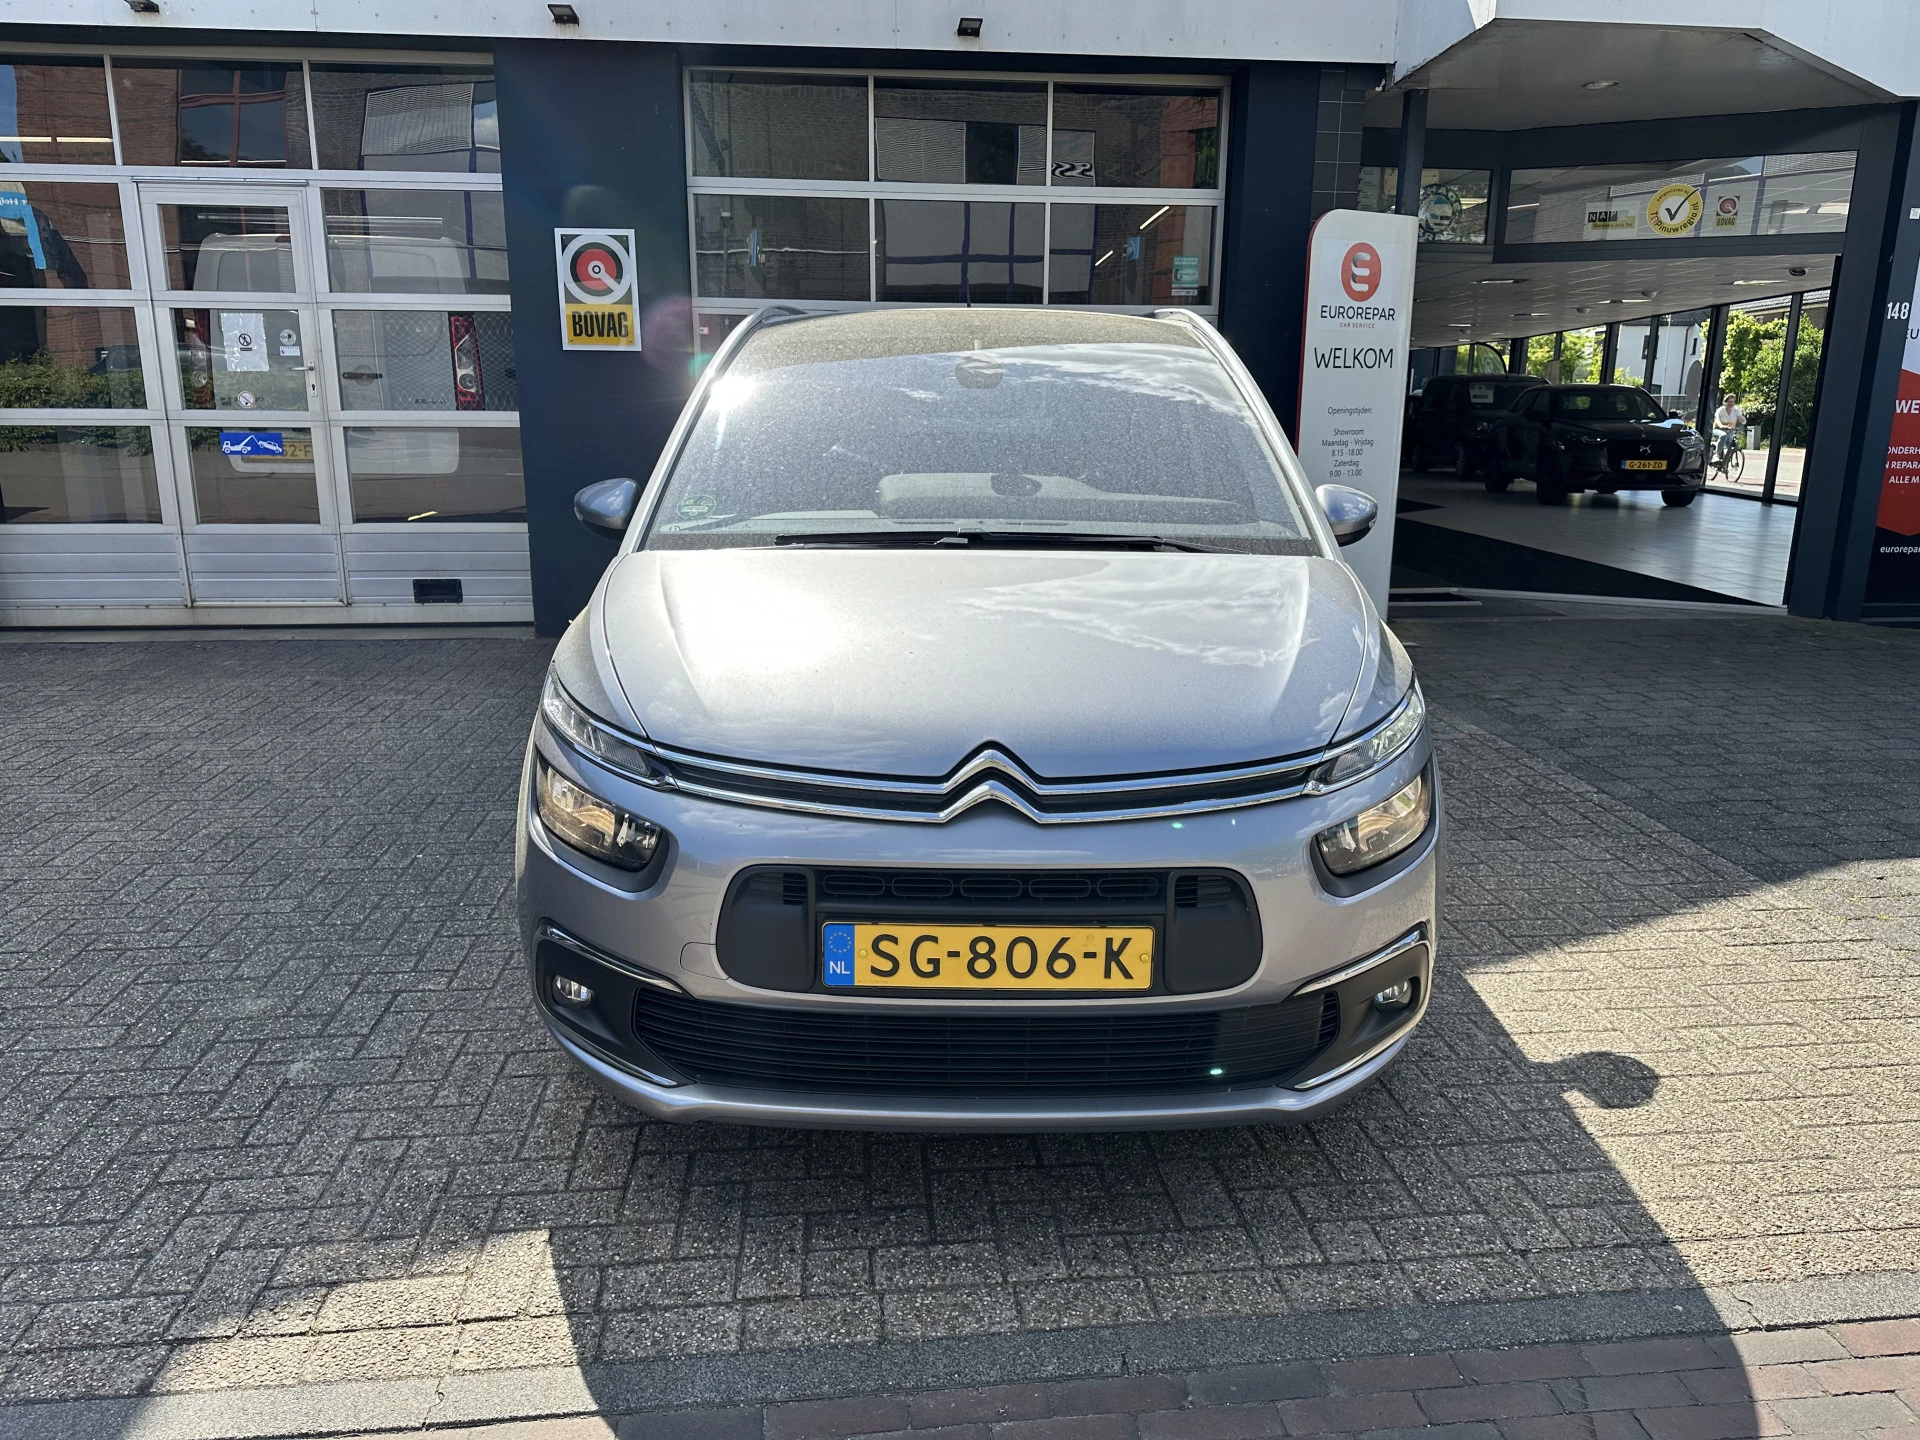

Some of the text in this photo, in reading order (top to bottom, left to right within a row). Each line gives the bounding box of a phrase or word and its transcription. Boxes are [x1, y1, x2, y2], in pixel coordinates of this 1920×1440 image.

[1716, 217, 1736, 227] BOVAG
[1320, 305, 1396, 321] EUROREPAR
[1886, 302, 1910, 320] 148
[571, 310, 629, 338] BOVAG
[1314, 347, 1394, 369] WELKOM
[1327, 406, 1372, 416] Openingstijden:
[1333, 428, 1364, 436] Showroom
[1321, 439, 1349, 448] Maandag
[1354, 438, 1374, 447] Vrijdag
[1331, 449, 1344, 457] 8.15
[1334, 459, 1360, 468] Zaterdag
[1629, 461, 1663, 469] G-261-ZD
[1329, 470, 1342, 478] 9.00
[1347, 469, 1363, 477] 13.00
[1888, 475, 1910, 484] ALLE
[870, 933, 1134, 980] SG-806-K
[829, 960, 851, 975] NL
